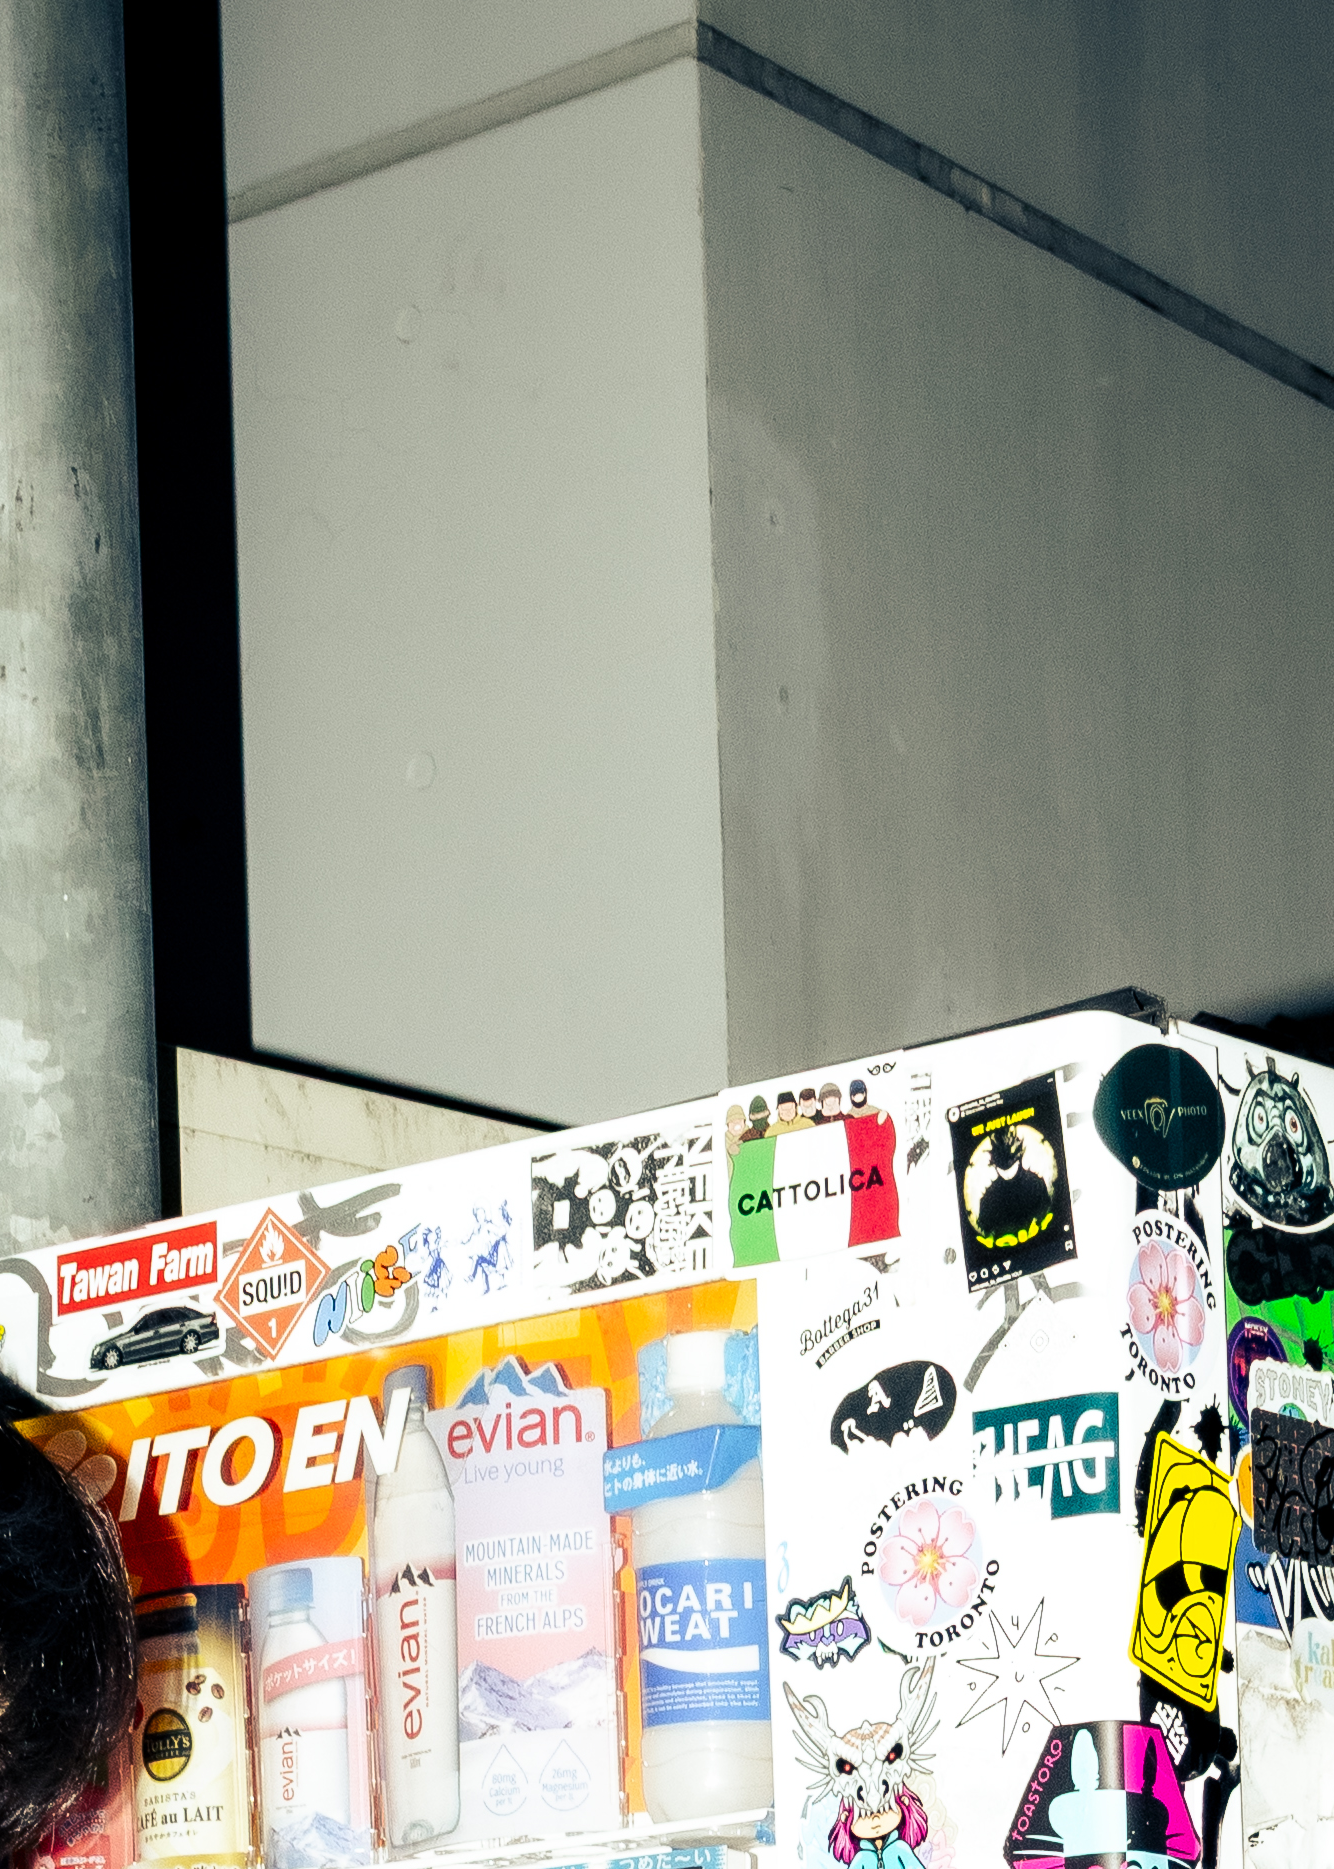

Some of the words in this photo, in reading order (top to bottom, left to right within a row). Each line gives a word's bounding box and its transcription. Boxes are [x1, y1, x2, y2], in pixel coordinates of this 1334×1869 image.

[1178, 1105, 1207, 1117] PHOTO
[736, 1167, 885, 1218] CATTOLICA
[59, 1257, 138, 1305] Tawan
[148, 1240, 216, 1286] Farm
[1131, 1219, 1217, 1312] POSTERING
[241, 1270, 303, 1308] SQU!D
[267, 1318, 277, 1339] 1
[853, 1321, 878, 1339] SHOP
[1119, 1320, 1197, 1394] TORONTO
[447, 1402, 583, 1460] evian
[118, 1416, 275, 1522] ITO
[283, 1386, 412, 1493] EN
[465, 1464, 499, 1484] Live
[503, 1458, 565, 1487] young
[860, 1476, 964, 1576] POSTERING
[465, 1531, 593, 1563] MOUNTAIN-MADE
[487, 1562, 565, 1587] MINERALS
[500, 1592, 529, 1607] FROM
[533, 1589, 554, 1603] THE
[640, 1581, 753, 1617] OCARI
[915, 1558, 1000, 1650] TORONTO
[477, 1612, 539, 1638] FRENCH
[542, 1608, 584, 1630] ALPS
[640, 1610, 738, 1645] WEAT
[397, 1596, 422, 1740] evian
[279, 1739, 295, 1802] evian
[542, 1780, 589, 1793] Magnesium
[489, 1785, 521, 1798] Calcium
[1012, 1737, 1063, 1841] TOASTORO
[160, 1811, 177, 1825] au
[183, 1805, 224, 1824] LAIT
